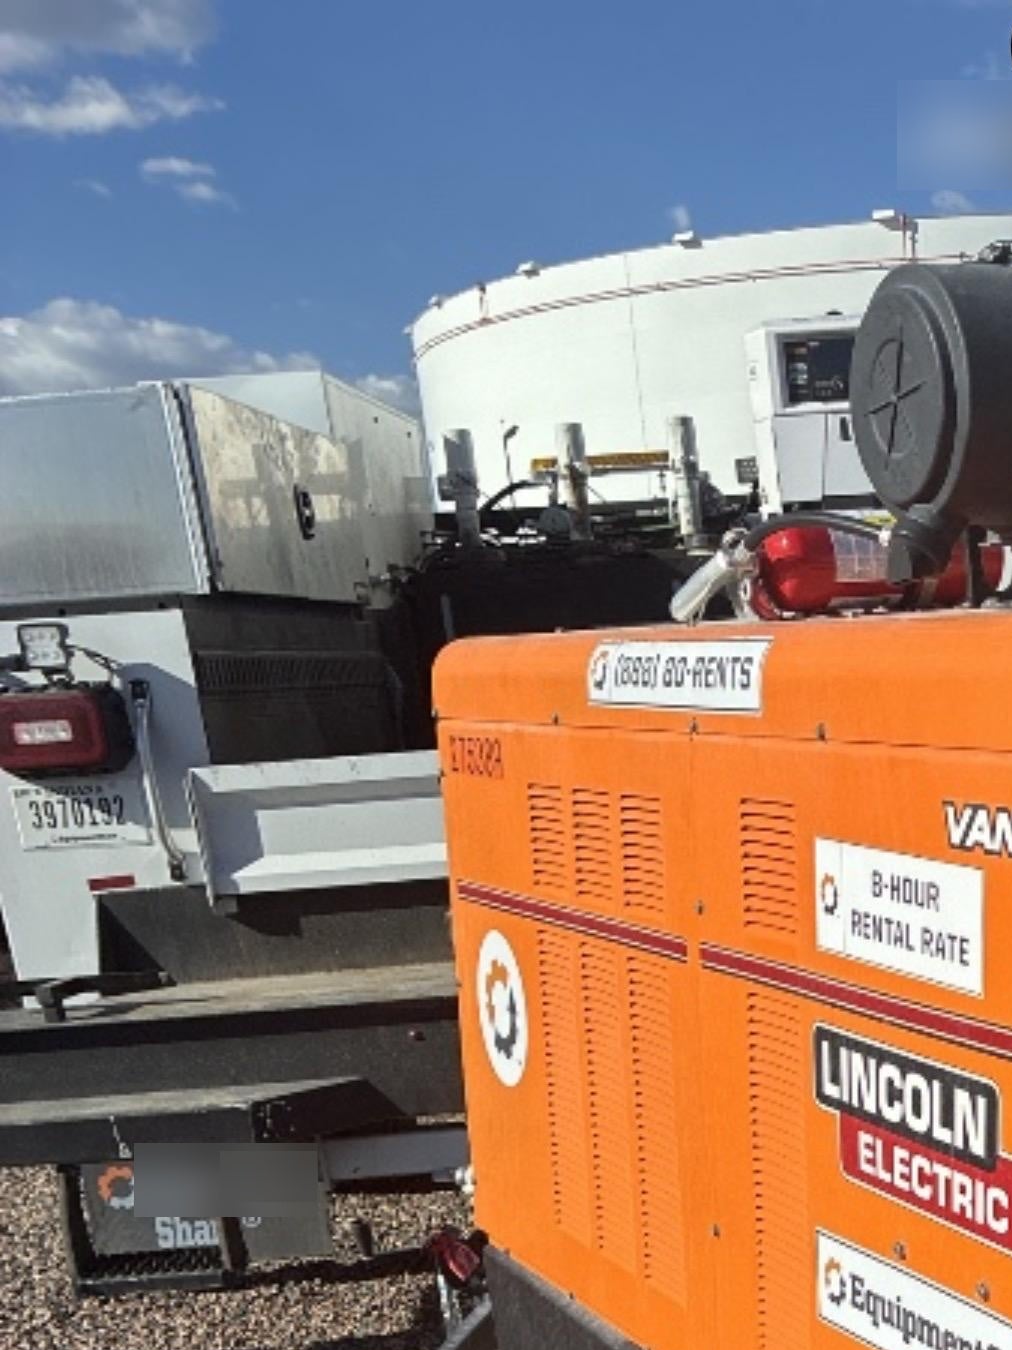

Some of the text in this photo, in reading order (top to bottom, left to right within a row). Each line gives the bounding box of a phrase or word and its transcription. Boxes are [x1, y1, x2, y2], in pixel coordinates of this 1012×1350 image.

[29, 795, 126, 829] 3970192
[871, 869, 940, 912] 8-HOUR
[851, 908, 970, 967] RENTAL RATE
[821, 1040, 989, 1158] LINCOLN
[857, 1130, 1010, 1235] ELECTRIC
